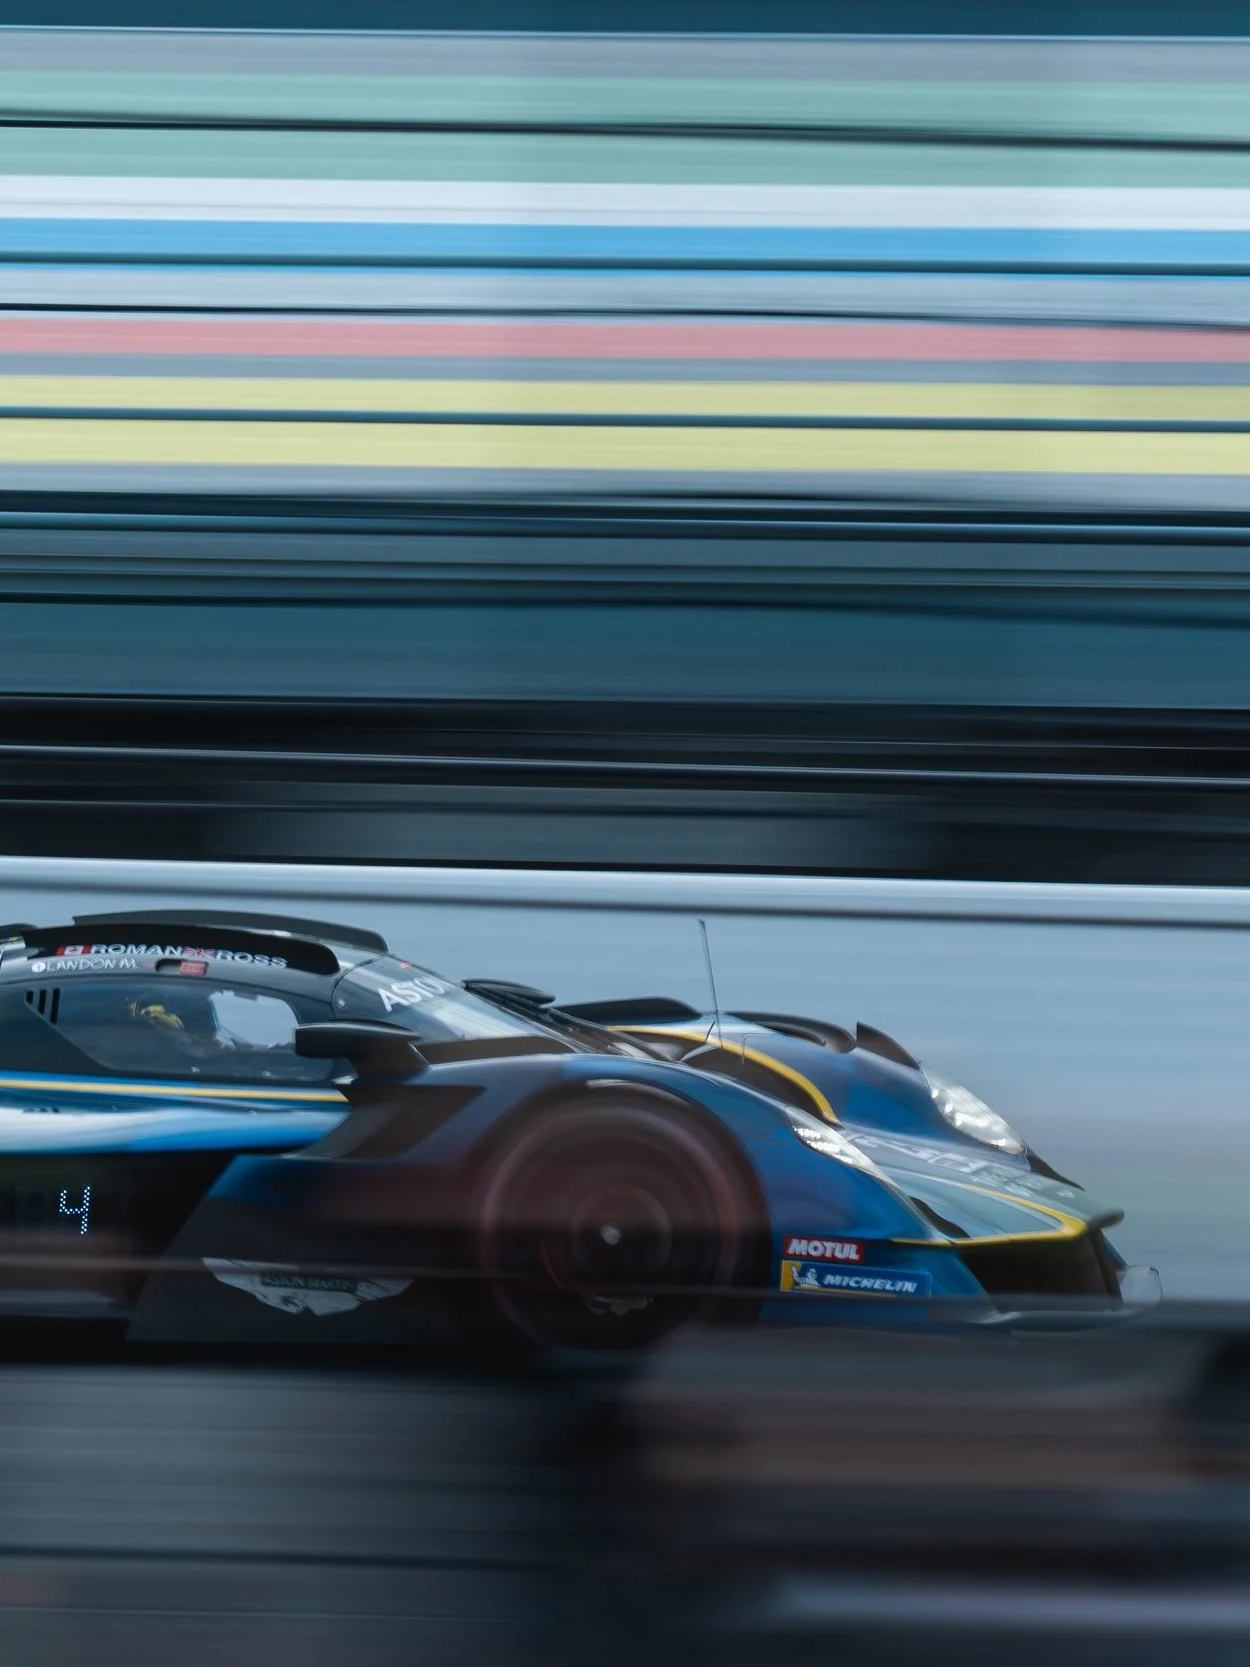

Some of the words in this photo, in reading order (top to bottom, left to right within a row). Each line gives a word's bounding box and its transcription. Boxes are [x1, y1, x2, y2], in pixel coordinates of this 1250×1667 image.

[91, 943, 182, 957] ROMAN
[216, 950, 289, 969] ROSS
[46, 957, 116, 972] LANDON
[59, 1185, 92, 1236] 4
[788, 1238, 860, 1261] MOTUL
[824, 1273, 918, 1294] MICHELIN
